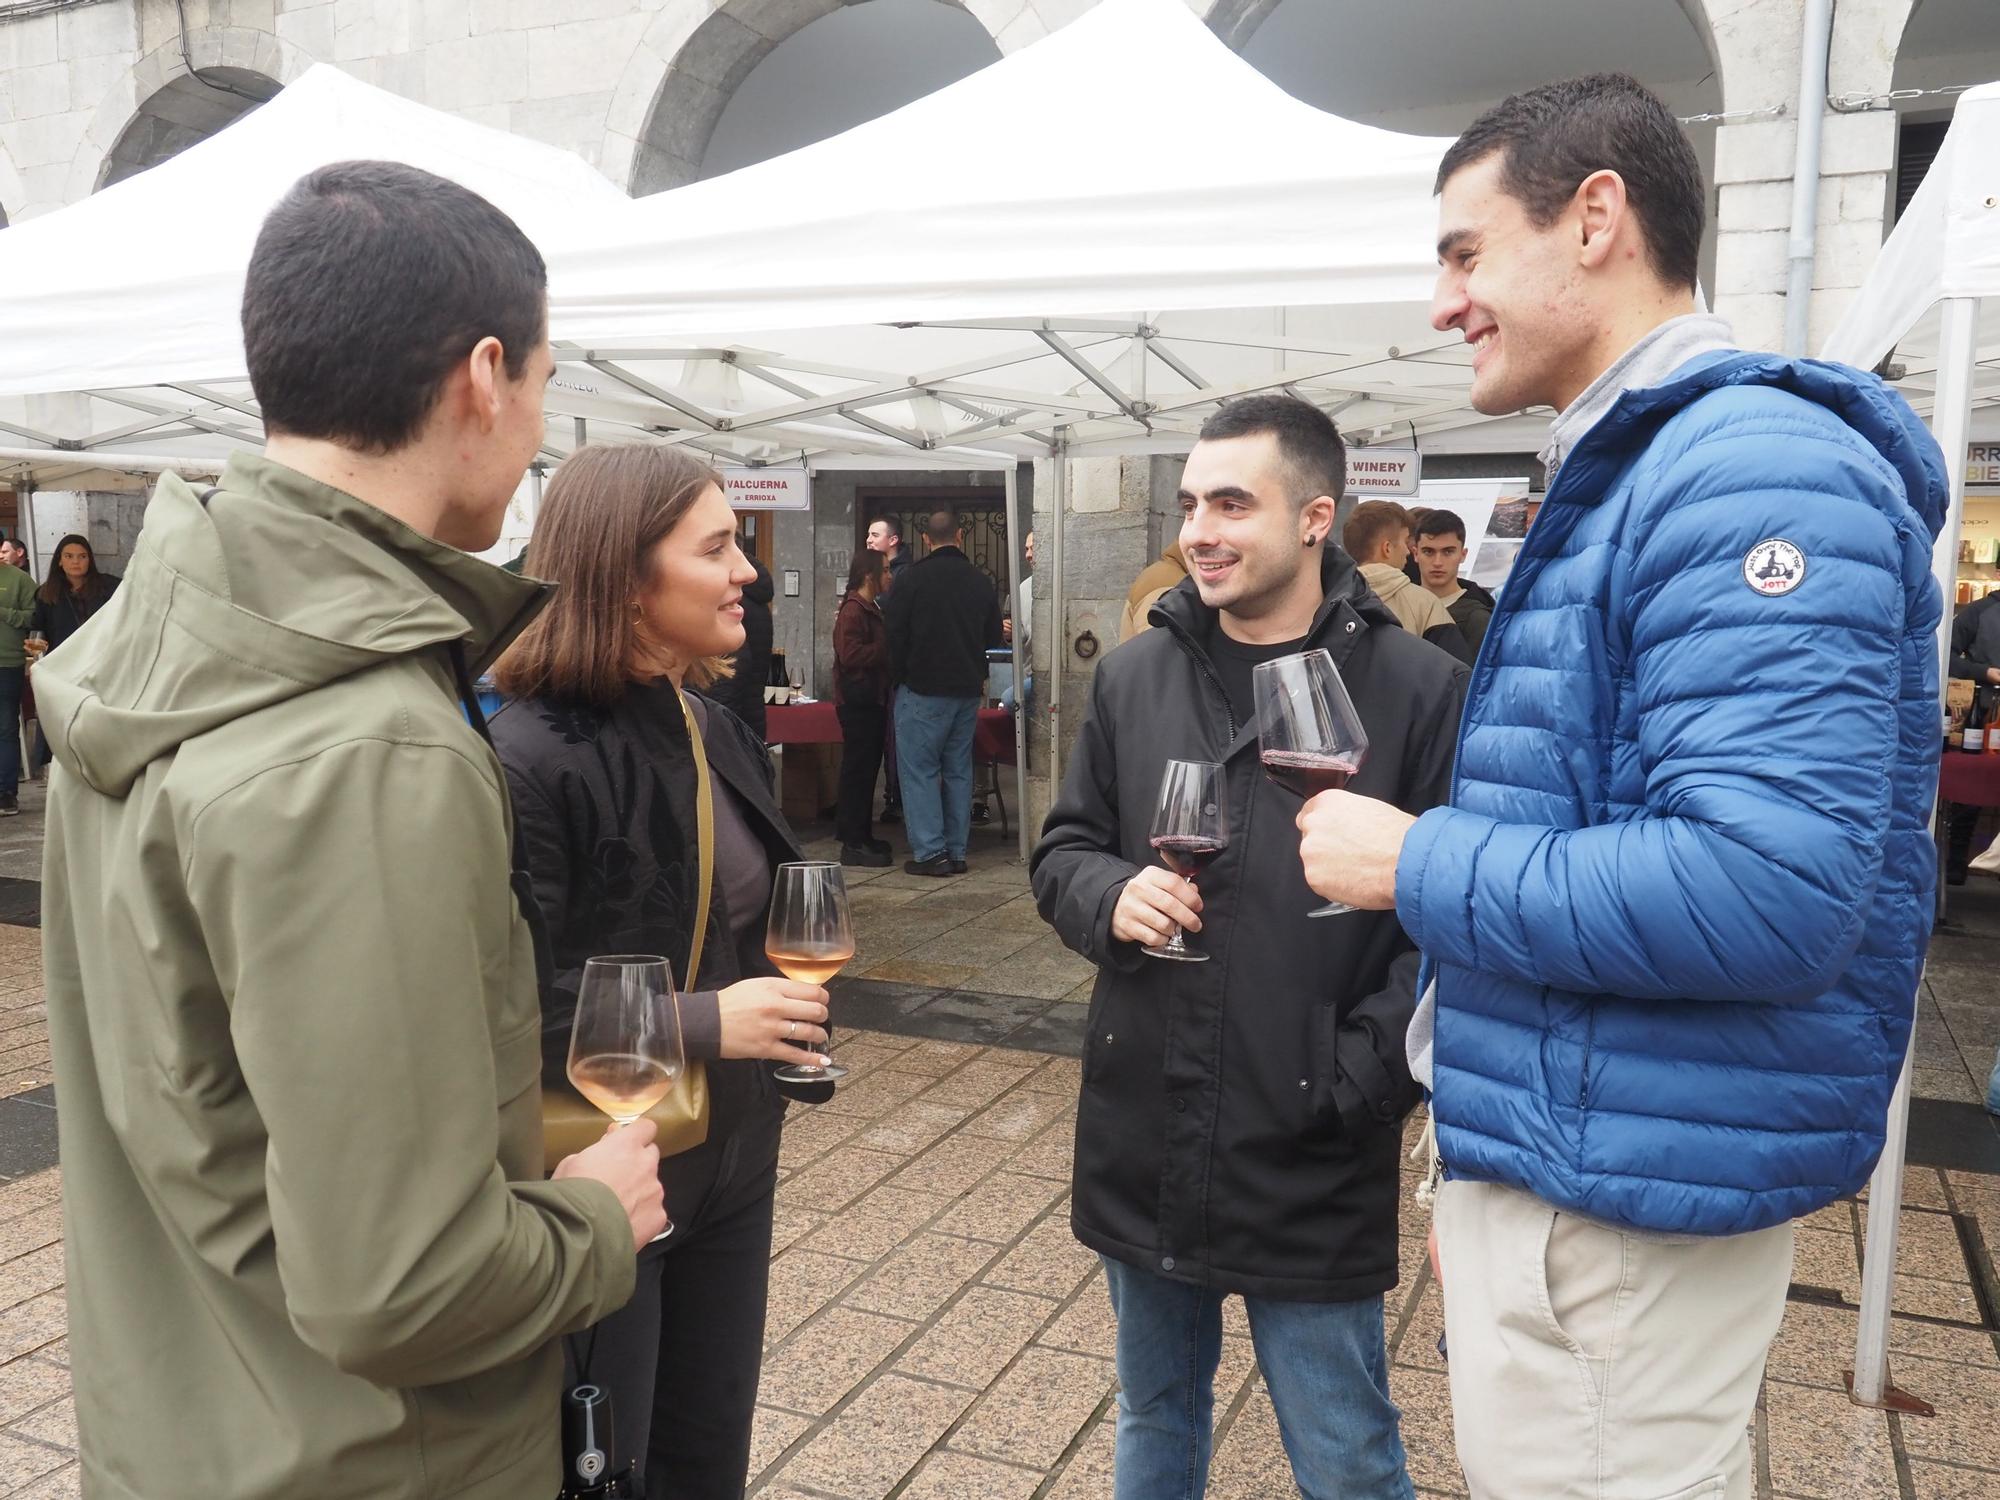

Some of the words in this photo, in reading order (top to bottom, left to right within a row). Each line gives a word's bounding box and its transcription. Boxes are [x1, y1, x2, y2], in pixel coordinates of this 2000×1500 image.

[1967, 447, 2000, 461] RR
[1353, 461, 1406, 472] WINERY
[727, 480, 788, 489] VALCUERNA
[1359, 478, 1400, 486] ERRIOXA
[1761, 581, 1787, 589] JOTT
